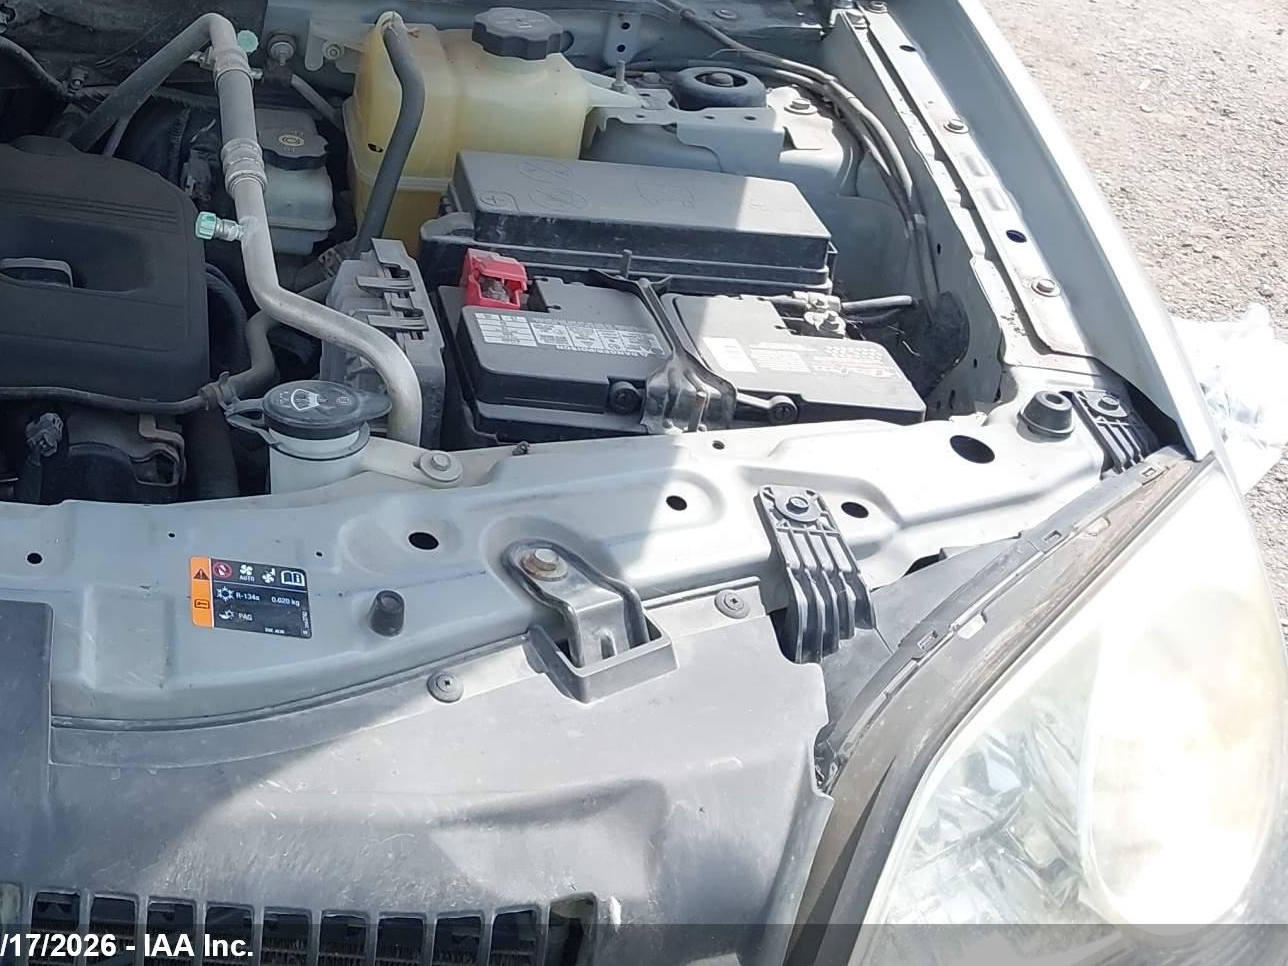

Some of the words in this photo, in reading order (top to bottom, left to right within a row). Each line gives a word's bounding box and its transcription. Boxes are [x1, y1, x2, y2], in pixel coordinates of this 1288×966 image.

[239, 574, 255, 582] AUTO
[291, 598, 300, 607] kg
[238, 612, 253, 621] PAG
